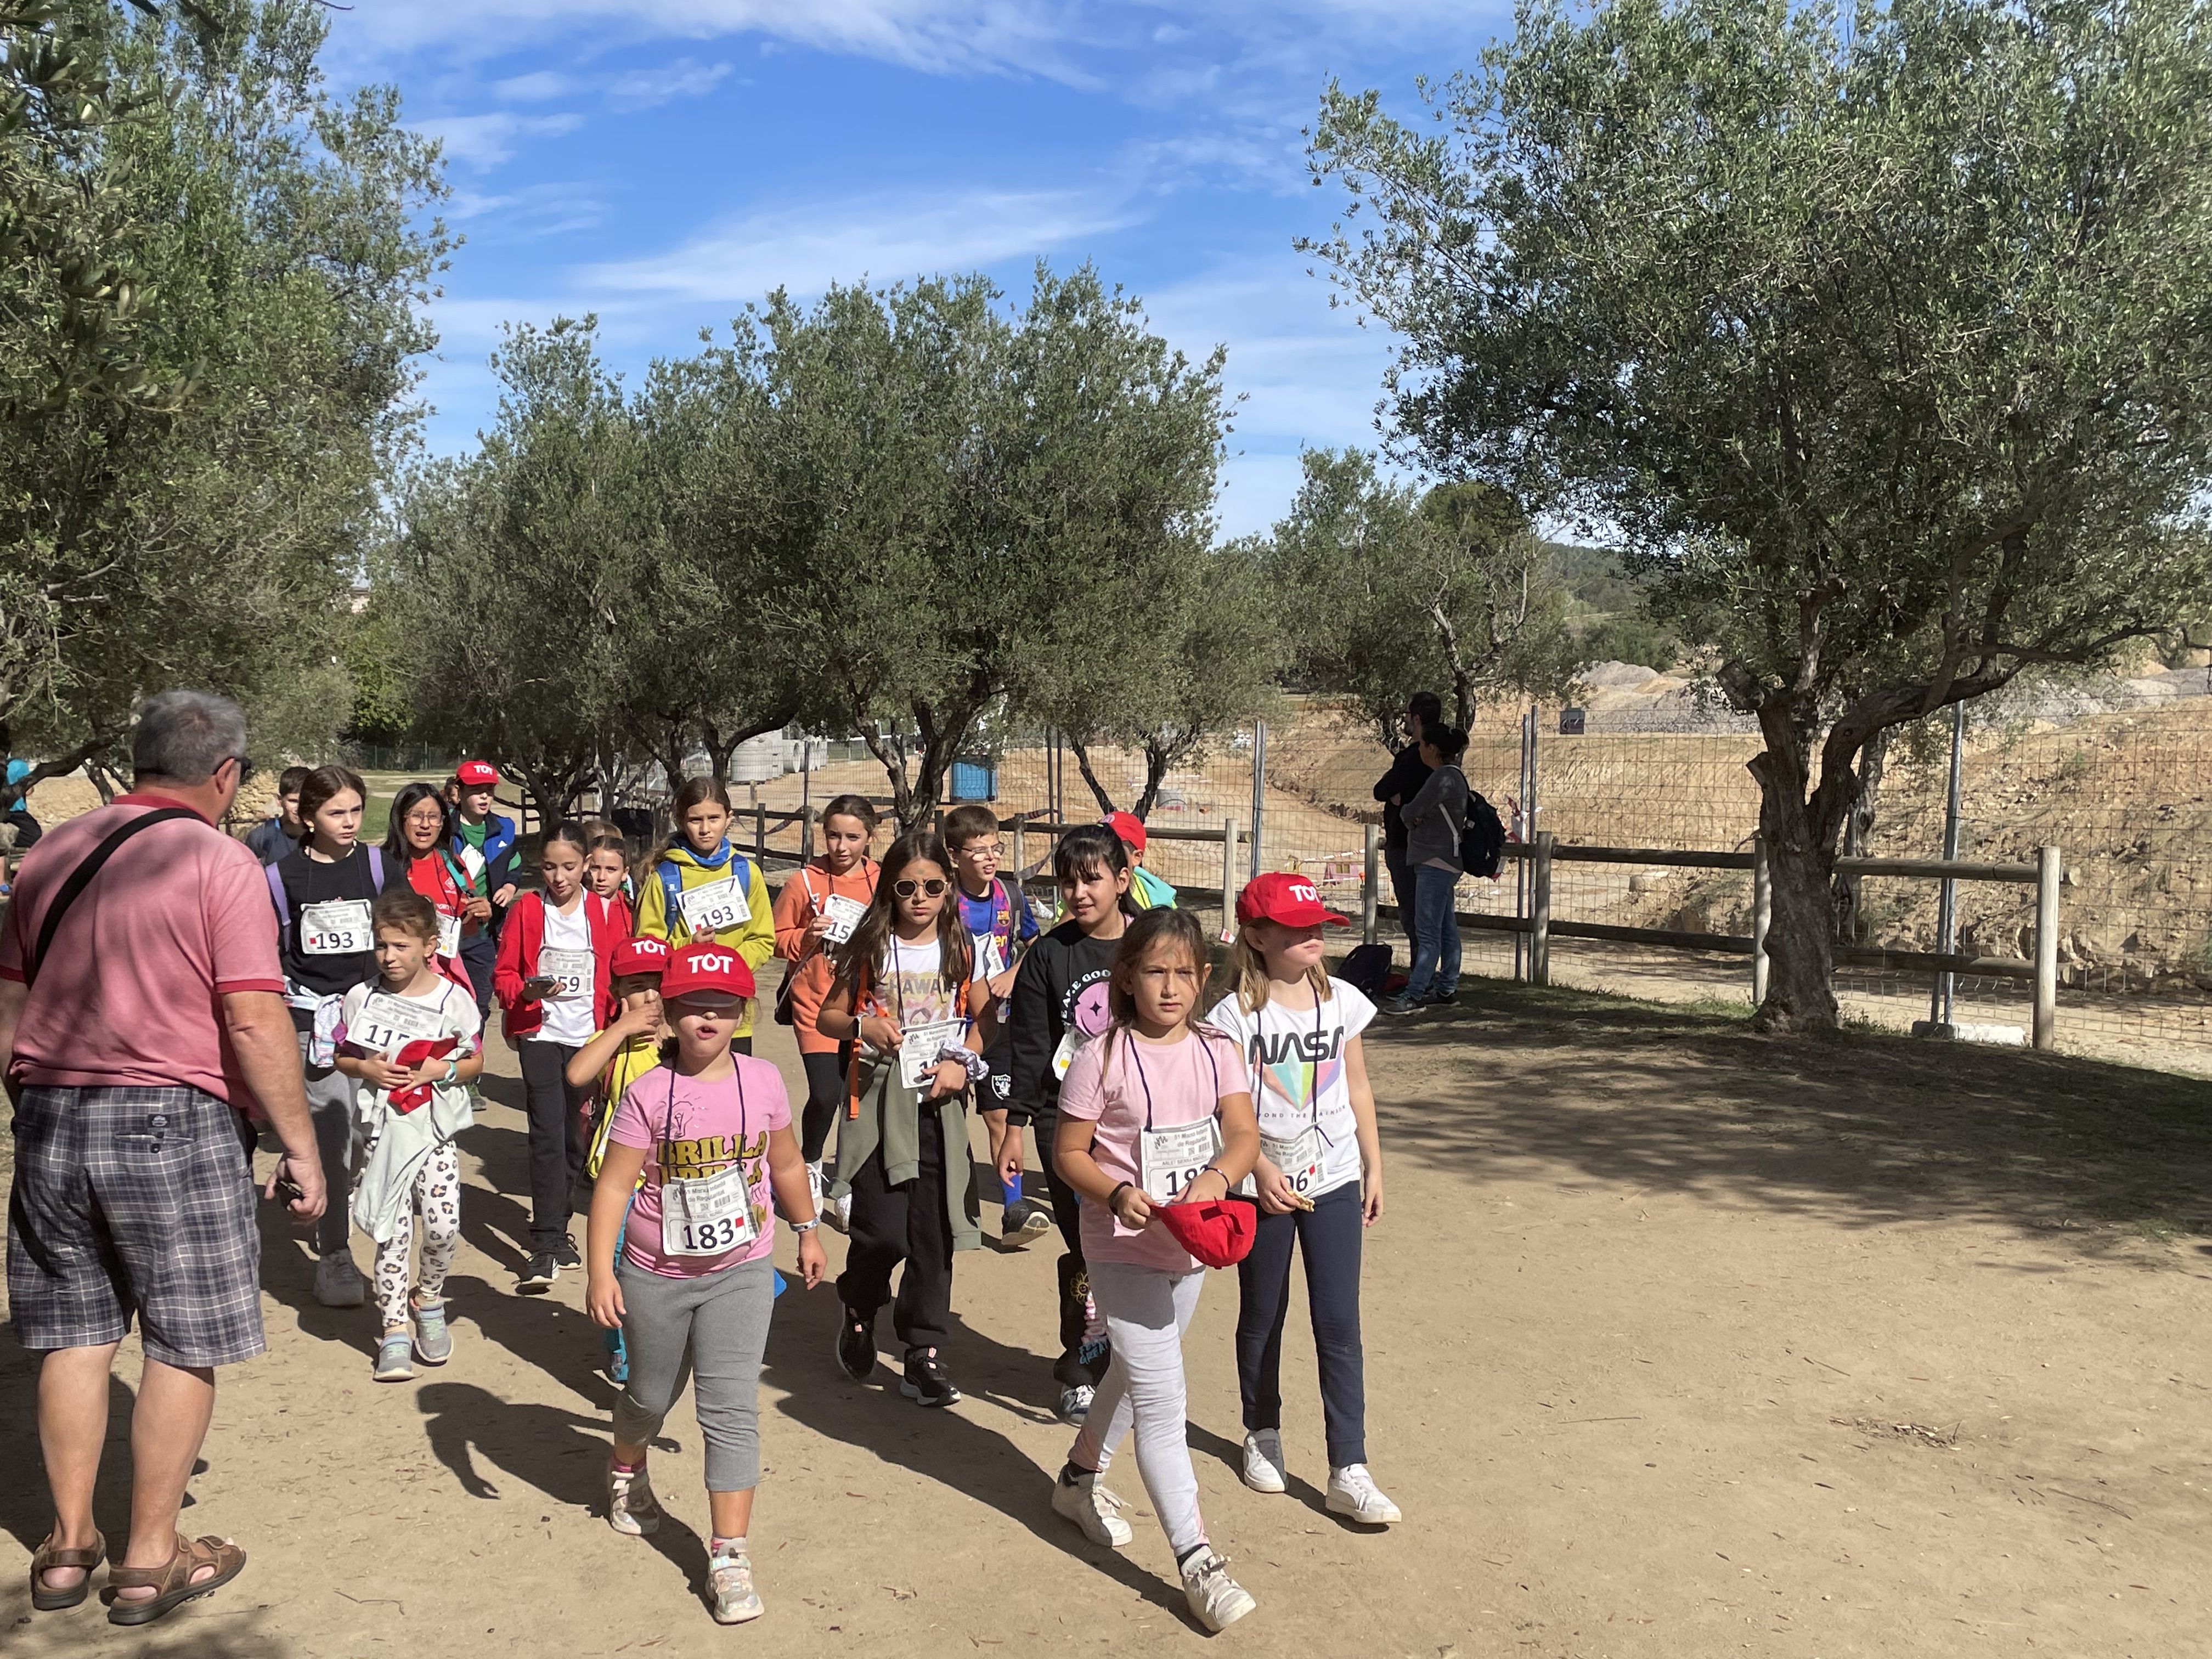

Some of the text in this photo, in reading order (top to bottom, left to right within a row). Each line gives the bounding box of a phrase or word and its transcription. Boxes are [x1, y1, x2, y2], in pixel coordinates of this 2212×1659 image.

[473, 765, 493, 775] TOT
[701, 906, 733, 927] 193
[828, 922, 850, 939] 15
[316, 932, 354, 949] 193
[631, 939, 667, 956] TOT
[687, 953, 734, 974] TOT
[558, 976, 580, 992] 59
[1249, 1026, 1344, 1065] NASA
[657, 1131, 768, 1165] BRILLA
[684, 1218, 734, 1250] 183
